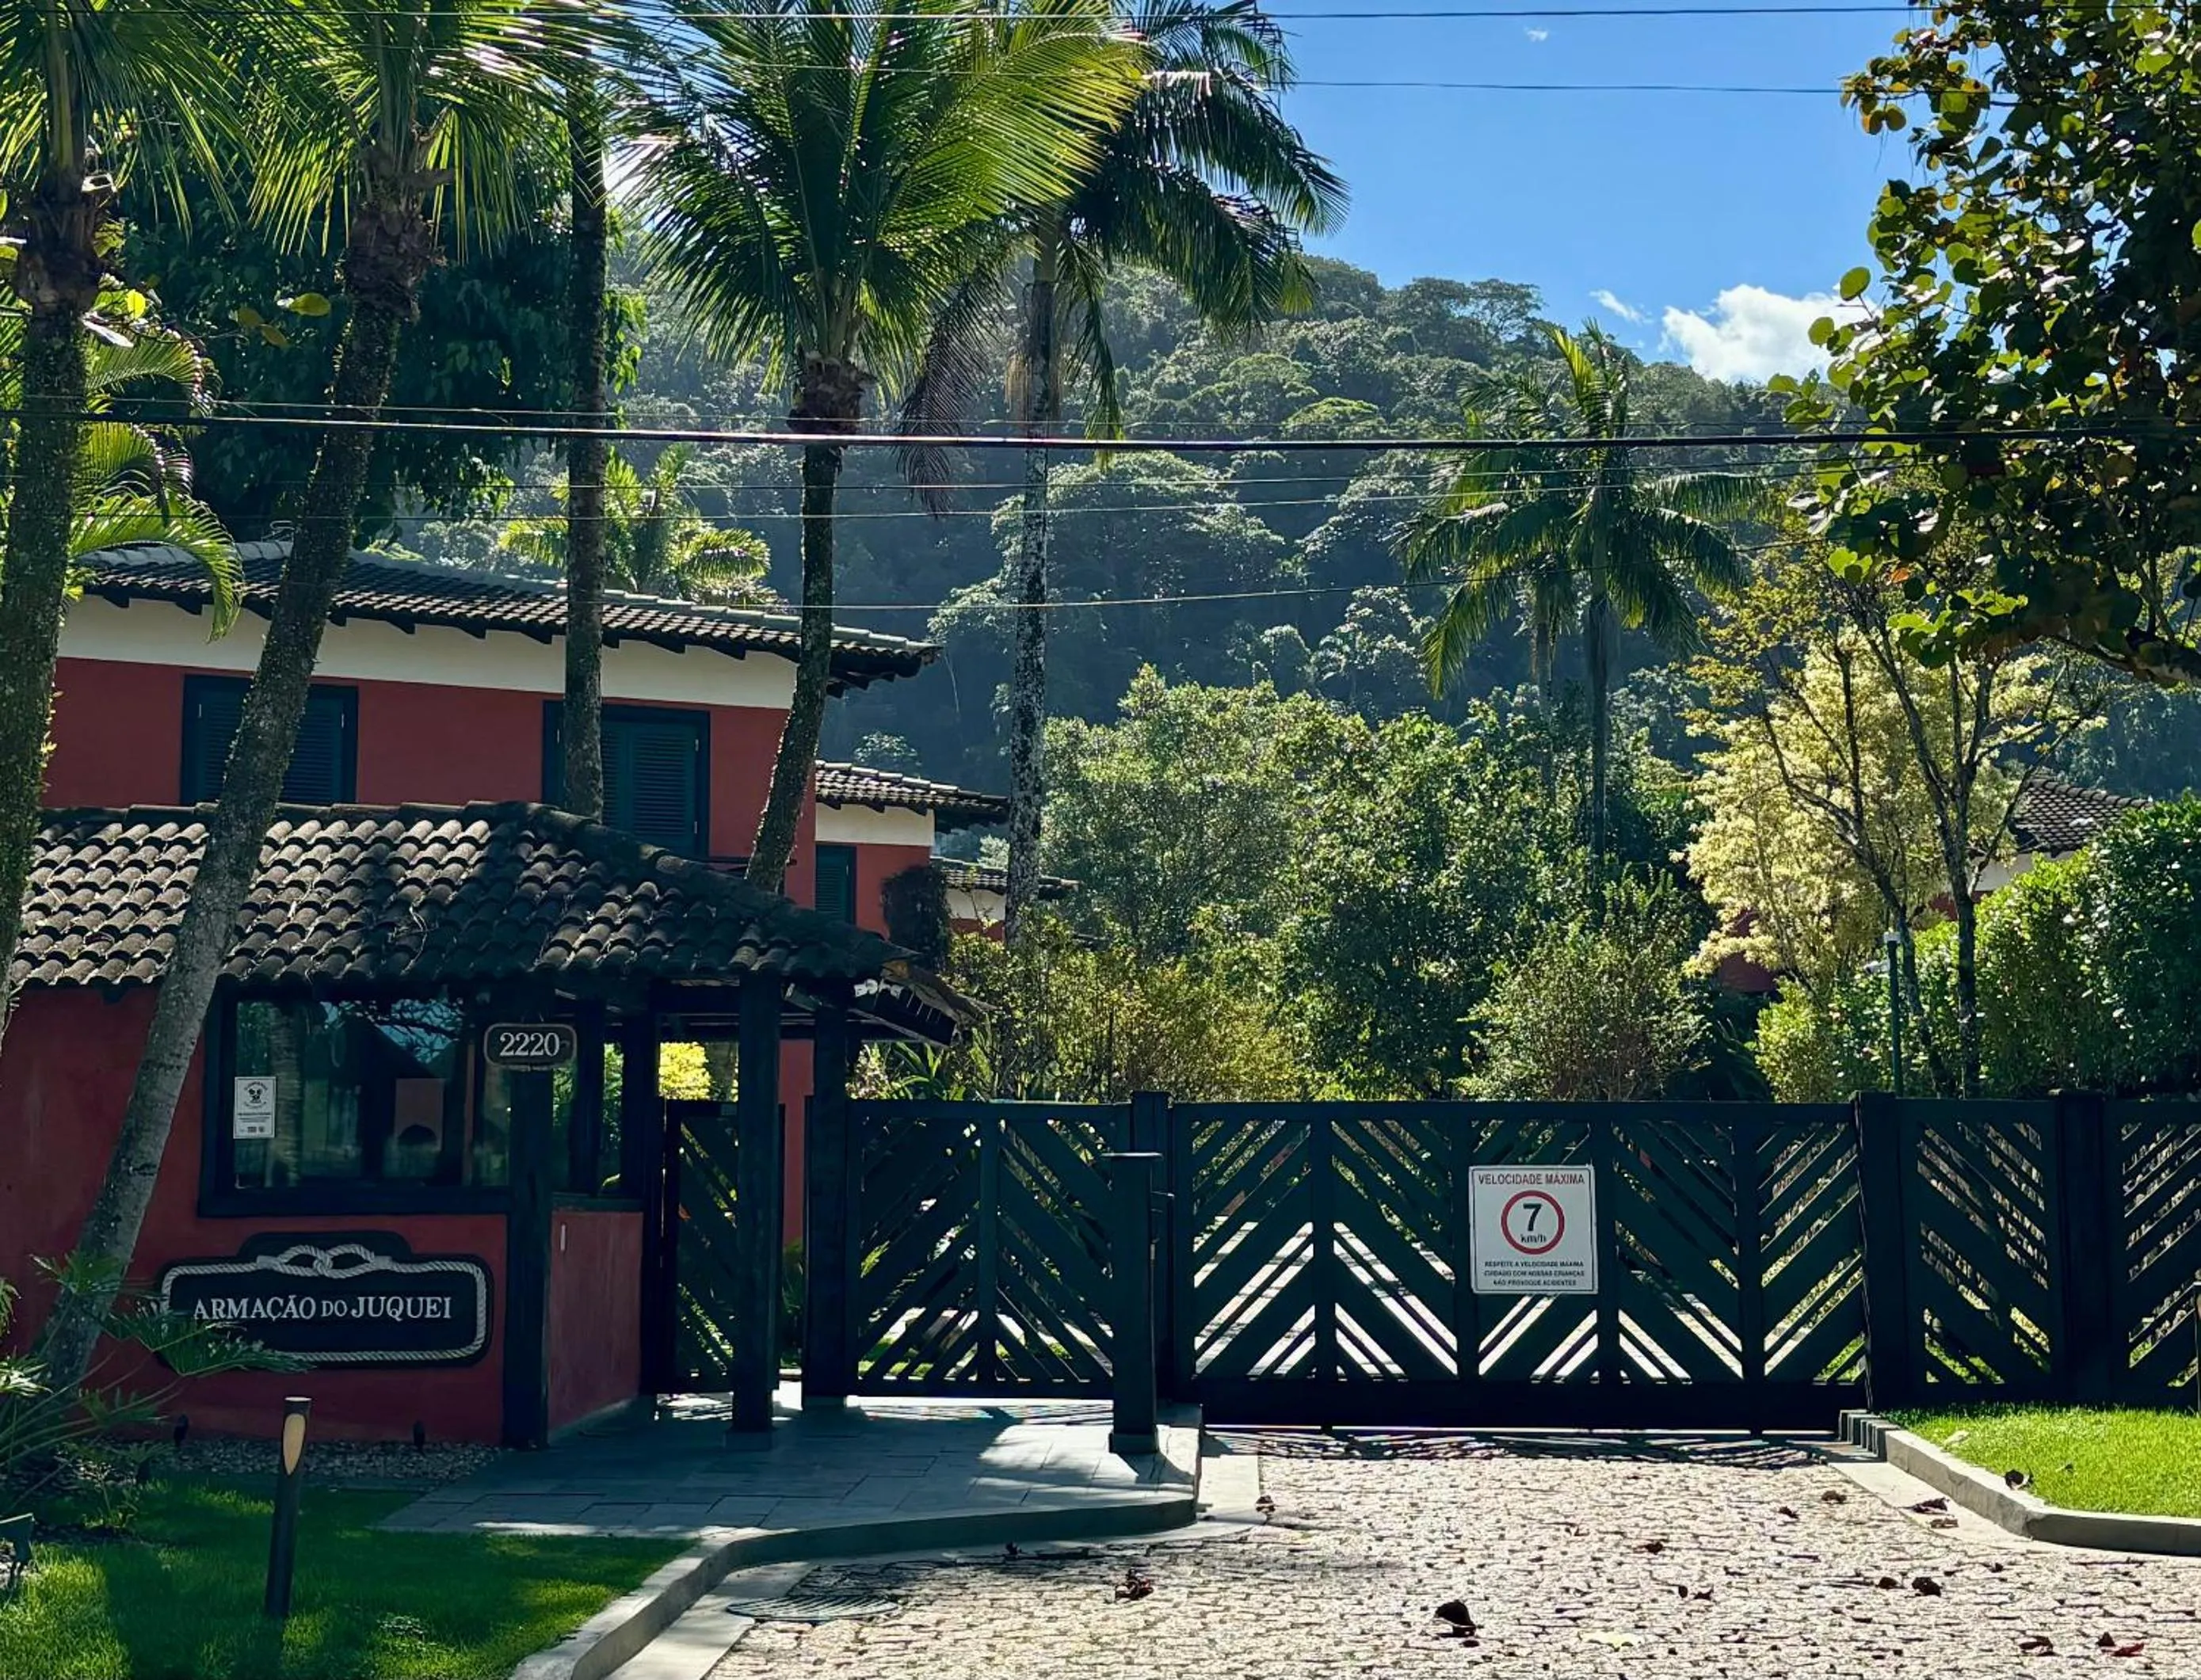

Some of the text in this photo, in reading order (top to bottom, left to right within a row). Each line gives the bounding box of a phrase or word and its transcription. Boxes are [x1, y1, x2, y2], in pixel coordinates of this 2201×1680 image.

[500, 1032, 559, 1057] 2220
[1478, 1171, 1585, 1185] VELOCIDADE MÁXIMA
[1523, 1203, 1543, 1232] 7
[1520, 1234, 1547, 1244] km/h
[193, 1295, 452, 1321] ARMAÇÃO DO JUQUEI
